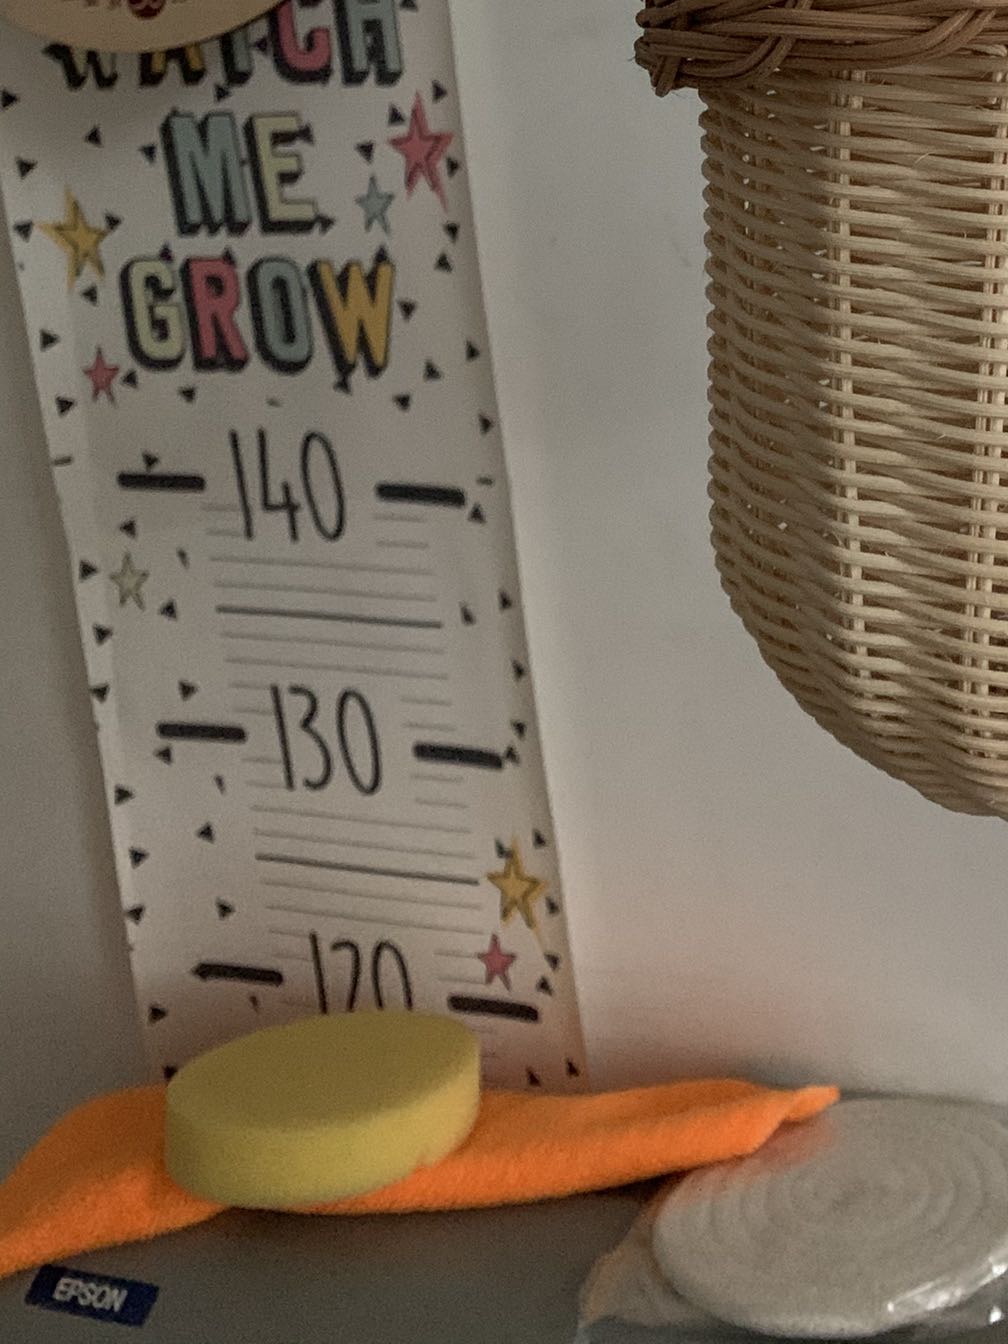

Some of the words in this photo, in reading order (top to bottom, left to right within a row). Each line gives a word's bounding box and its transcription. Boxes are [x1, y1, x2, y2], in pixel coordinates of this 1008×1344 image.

[161, 111, 322, 235] ME
[120, 256, 394, 378] GROW
[229, 428, 345, 541] 140
[270, 685, 381, 795] 130
[52, 1277, 128, 1312] EPSON
